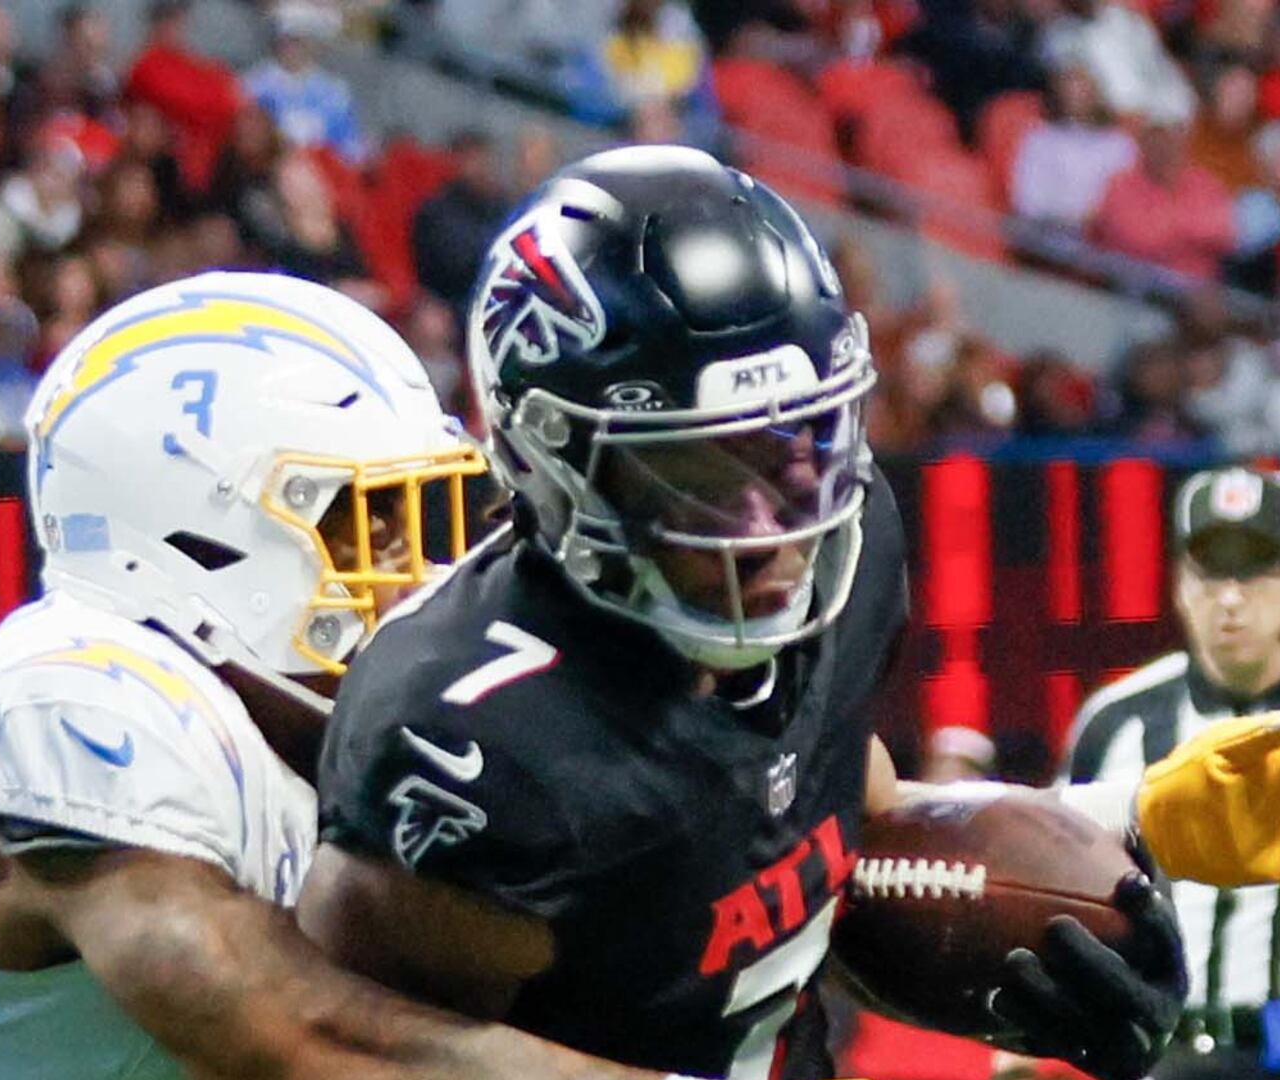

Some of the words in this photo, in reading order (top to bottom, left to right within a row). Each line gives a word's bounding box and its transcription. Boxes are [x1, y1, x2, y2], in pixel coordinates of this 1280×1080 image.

[163, 370, 217, 458] 3
[731, 359, 790, 394] ATL
[440, 619, 562, 706] 7
[699, 814, 857, 977] ATL
